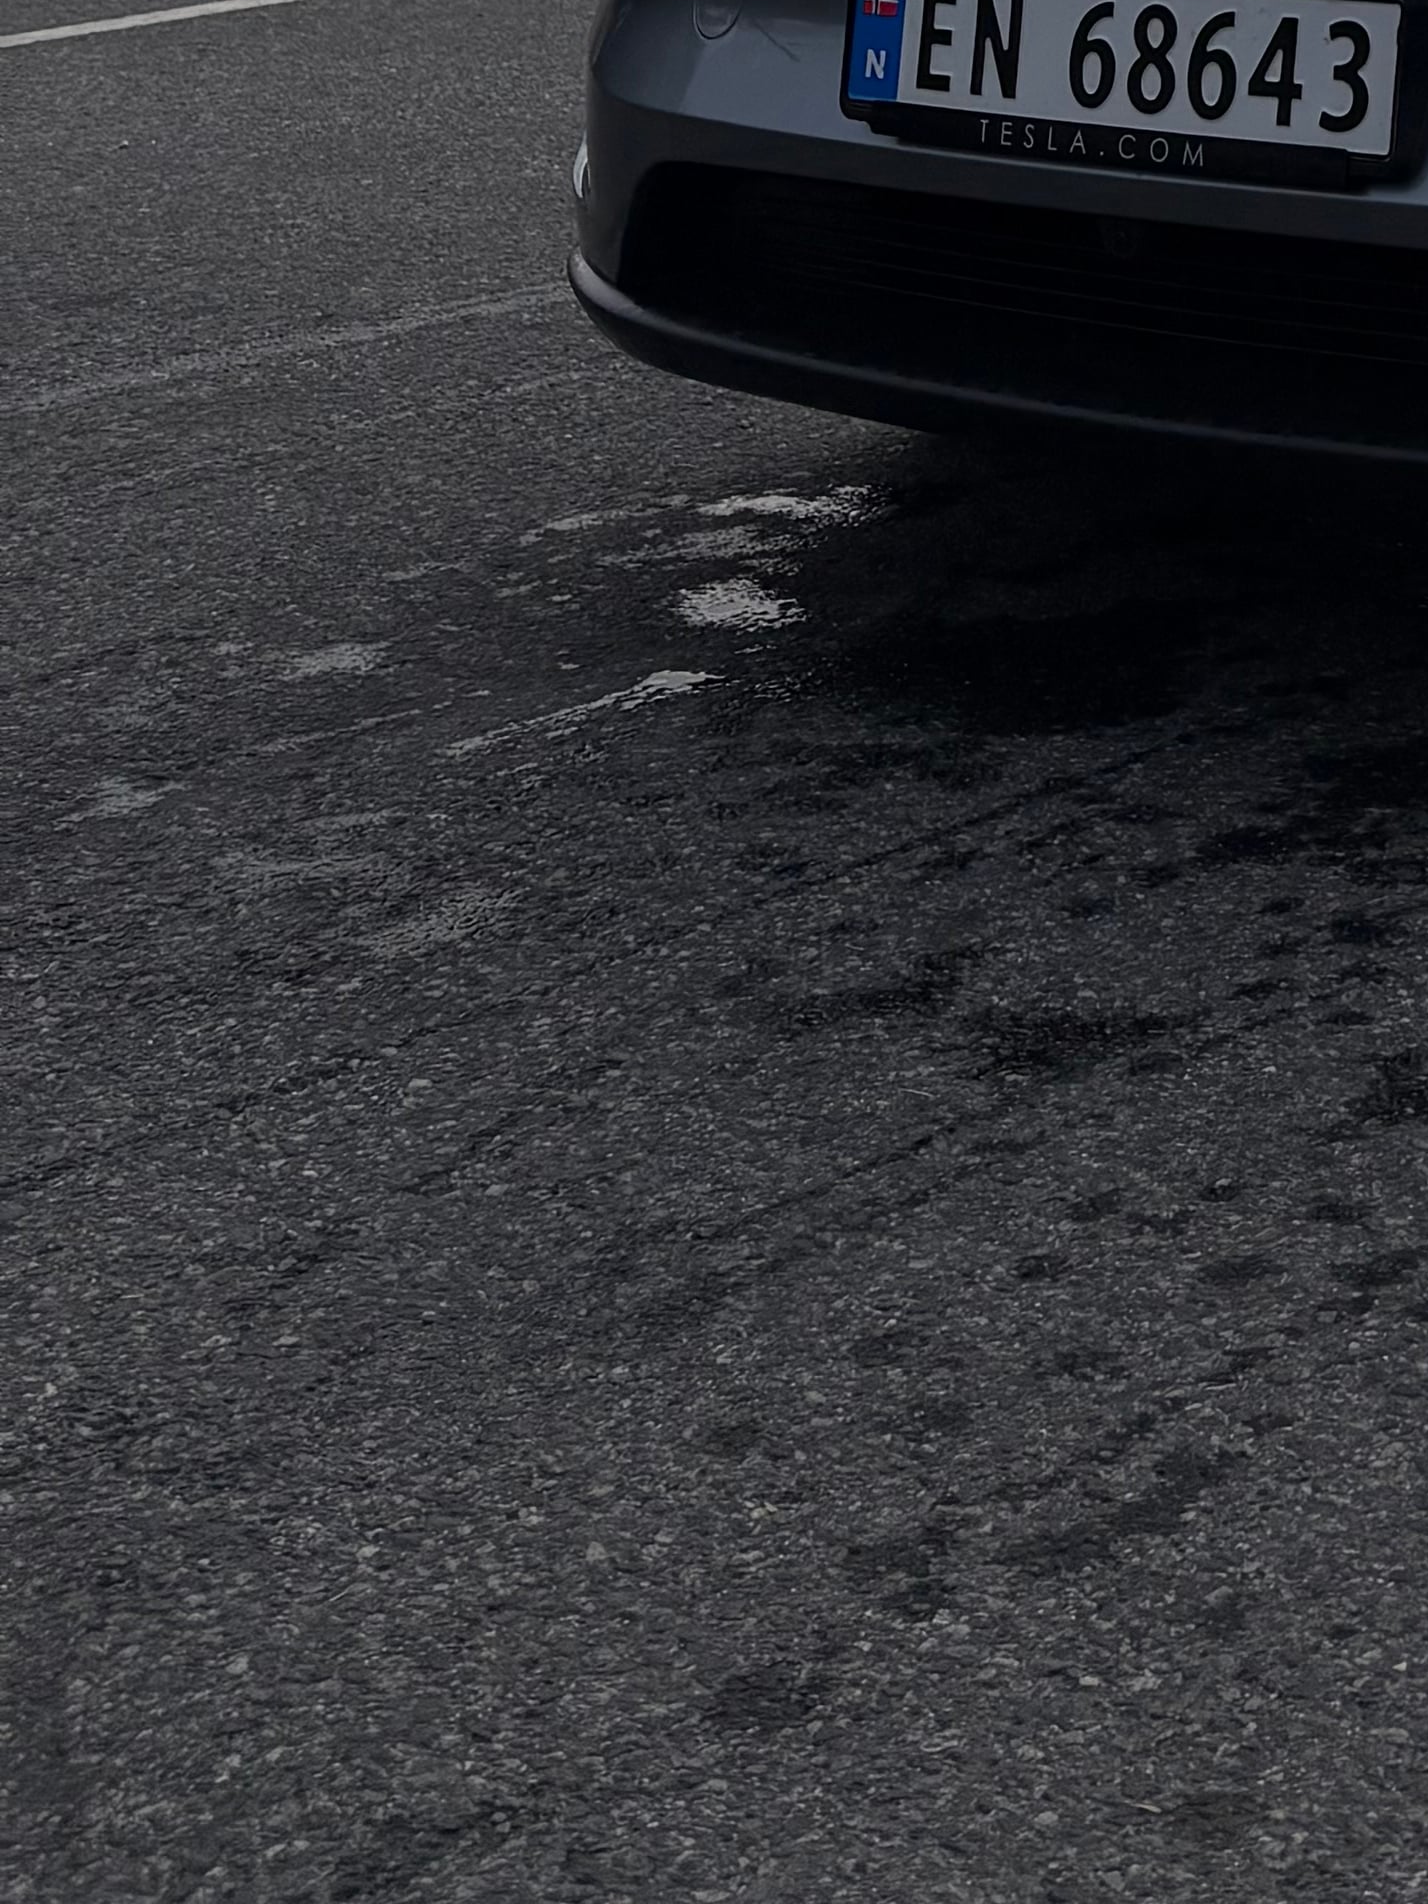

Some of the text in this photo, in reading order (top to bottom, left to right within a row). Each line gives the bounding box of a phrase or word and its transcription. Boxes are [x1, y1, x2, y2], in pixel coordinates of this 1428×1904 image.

[865, 48, 886, 80] N
[1068, 0, 1372, 133] 68643
[979, 118, 1205, 168] TESLA.COM
